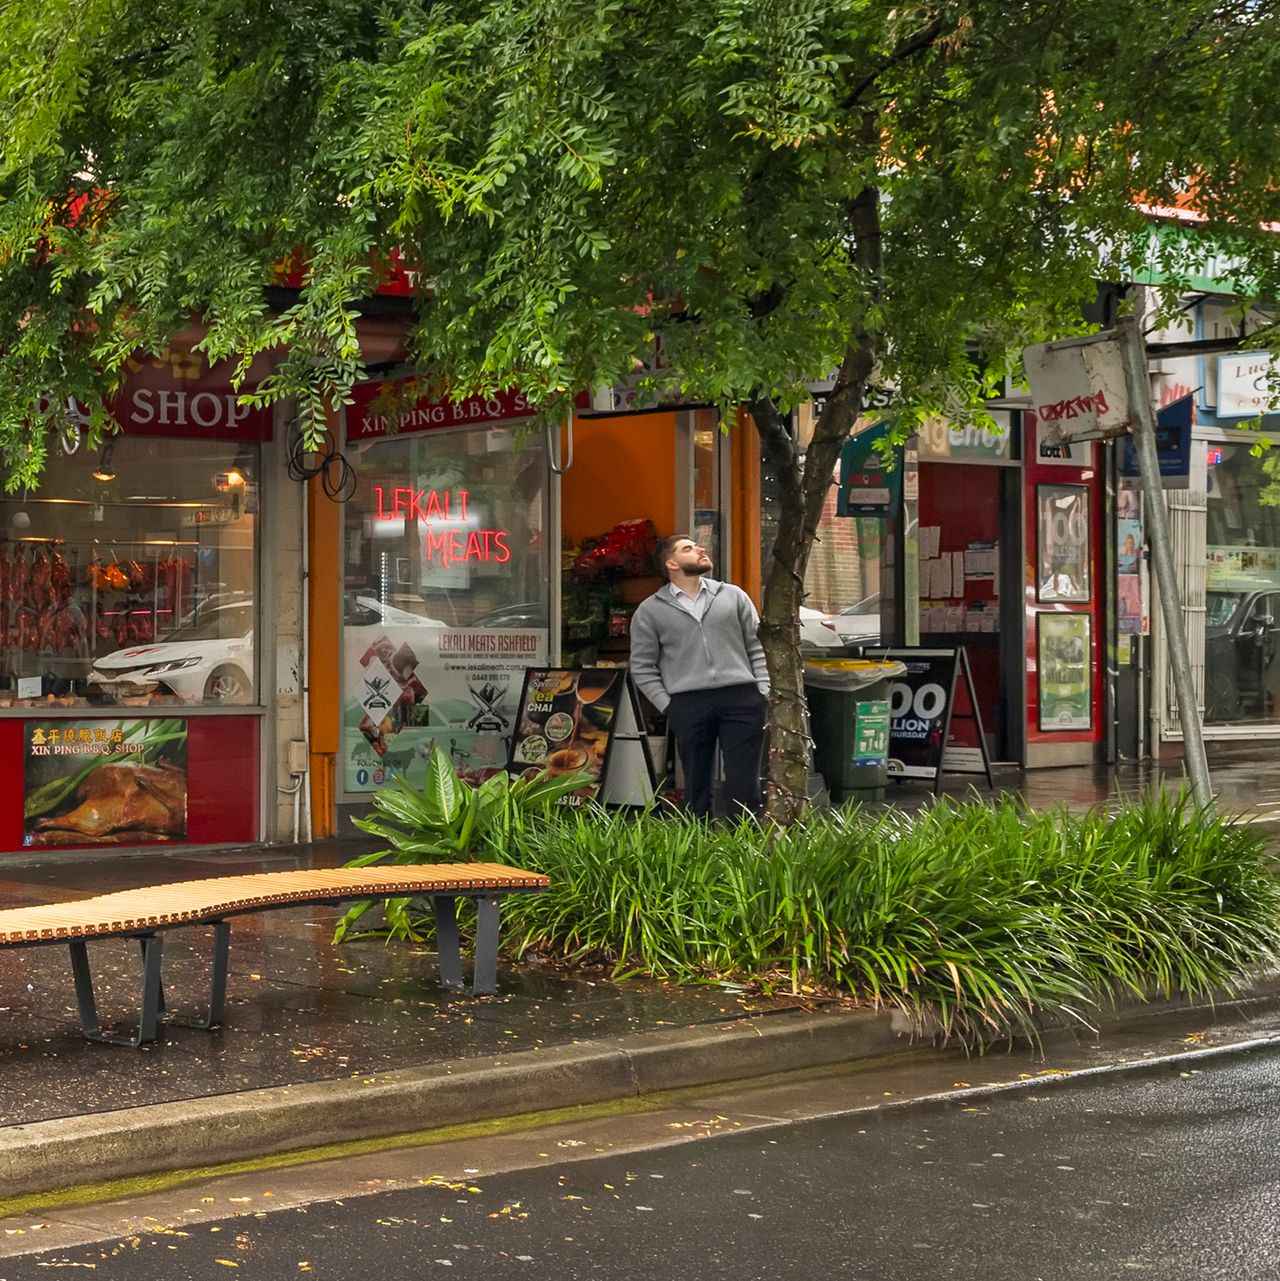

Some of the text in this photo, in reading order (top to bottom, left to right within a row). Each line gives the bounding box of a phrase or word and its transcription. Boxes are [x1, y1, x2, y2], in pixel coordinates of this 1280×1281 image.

[130, 388, 252, 429] SHOP
[400, 407, 445, 427] PING
[452, 398, 506, 420] B.B.Q.
[373, 486, 470, 528] LEKALI
[426, 529, 511, 569] MEATS
[439, 634, 537, 652] LEKALI MEATS ASHFIELD
[526, 703, 553, 713] CHAI
[890, 719, 930, 731] LION
[890, 731, 929, 739] HURSDAY
[31, 745, 51, 756] XIN
[54, 744, 80, 755] PING
[115, 743, 145, 754] SHOP
